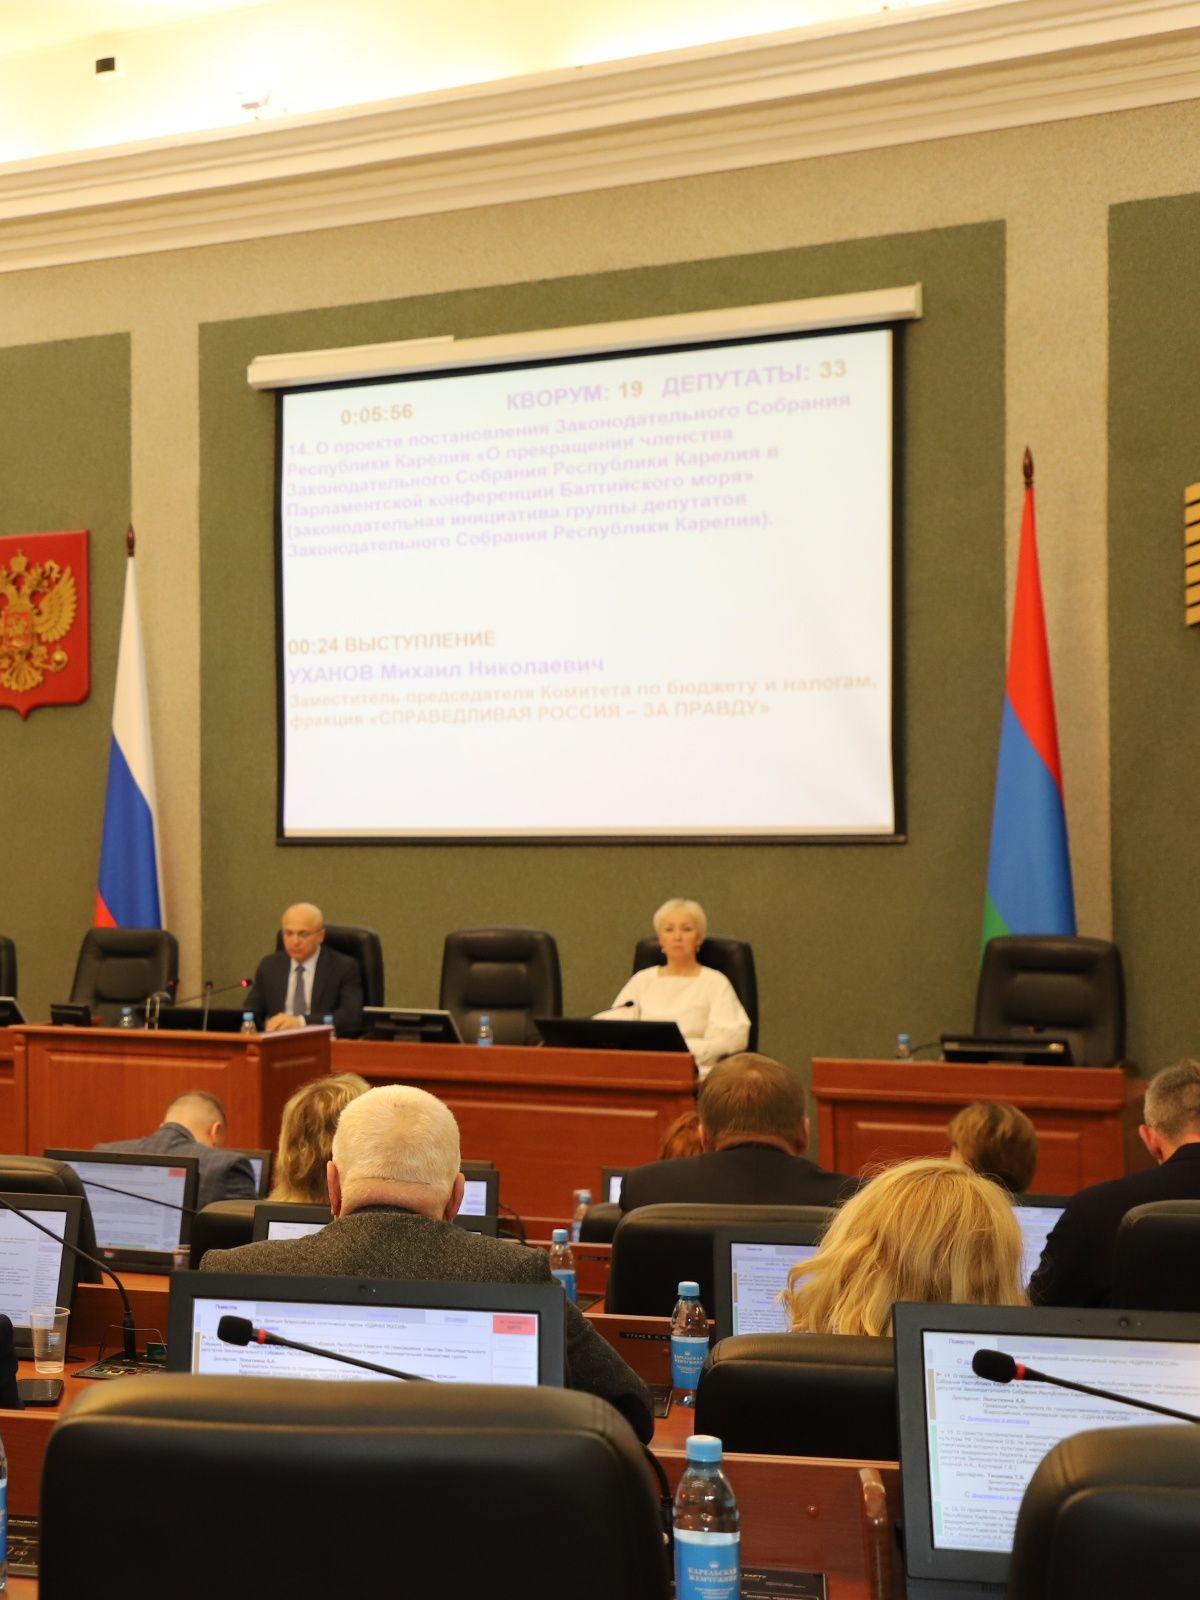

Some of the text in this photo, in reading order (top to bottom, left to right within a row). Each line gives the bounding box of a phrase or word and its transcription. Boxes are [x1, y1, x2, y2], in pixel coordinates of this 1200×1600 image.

[507, 359, 847, 411] КВОРУМ: 19 ДЕПУТАТЫ: 33
[316, 441, 329, 455] О
[336, 437, 402, 459] проекте
[408, 423, 549, 445] постановления
[554, 405, 739, 434] Законодательного
[746, 394, 851, 417] Собрания
[340, 403, 413, 425] 0:05:56
[287, 454, 390, 477] Республики
[396, 452, 470, 472] Карелия
[506, 438, 634, 461] прекращении
[639, 429, 733, 448] членства
[287, 474, 450, 497] Законодательного
[455, 465, 547, 489] Собрания
[553, 456, 668, 476] Республики
[674, 449, 759, 469] Карелия
[287, 495, 423, 519] Парламентской
[428, 486, 554, 507] конференции
[560, 475, 683, 497] Балтийского
[450, 507, 559, 527] инициатива
[565, 501, 636, 522] группы
[641, 493, 747, 516] депутатов
[287, 535, 450, 558] Законодательного
[455, 528, 547, 550] Собрания
[553, 519, 668, 540] Республики
[288, 629, 497, 656] 00:24 ВЫСТУПЛЕНИЕ
[288, 657, 605, 684] УХАНОВ Михаил Николаевич
[290, 692, 400, 707] Заместитель
[407, 687, 535, 706] председателя
[540, 682, 631, 700] Комитета
[637, 682, 661, 697] по
[667, 675, 757, 697] бюджету
[764, 679, 777, 692] и
[290, 712, 364, 732] фракция
[370, 705, 531, 725] «СПРАВЕДЛИВАЯ
[538, 702, 621, 721] РОССИЯ
[643, 701, 669, 718] ЗА
